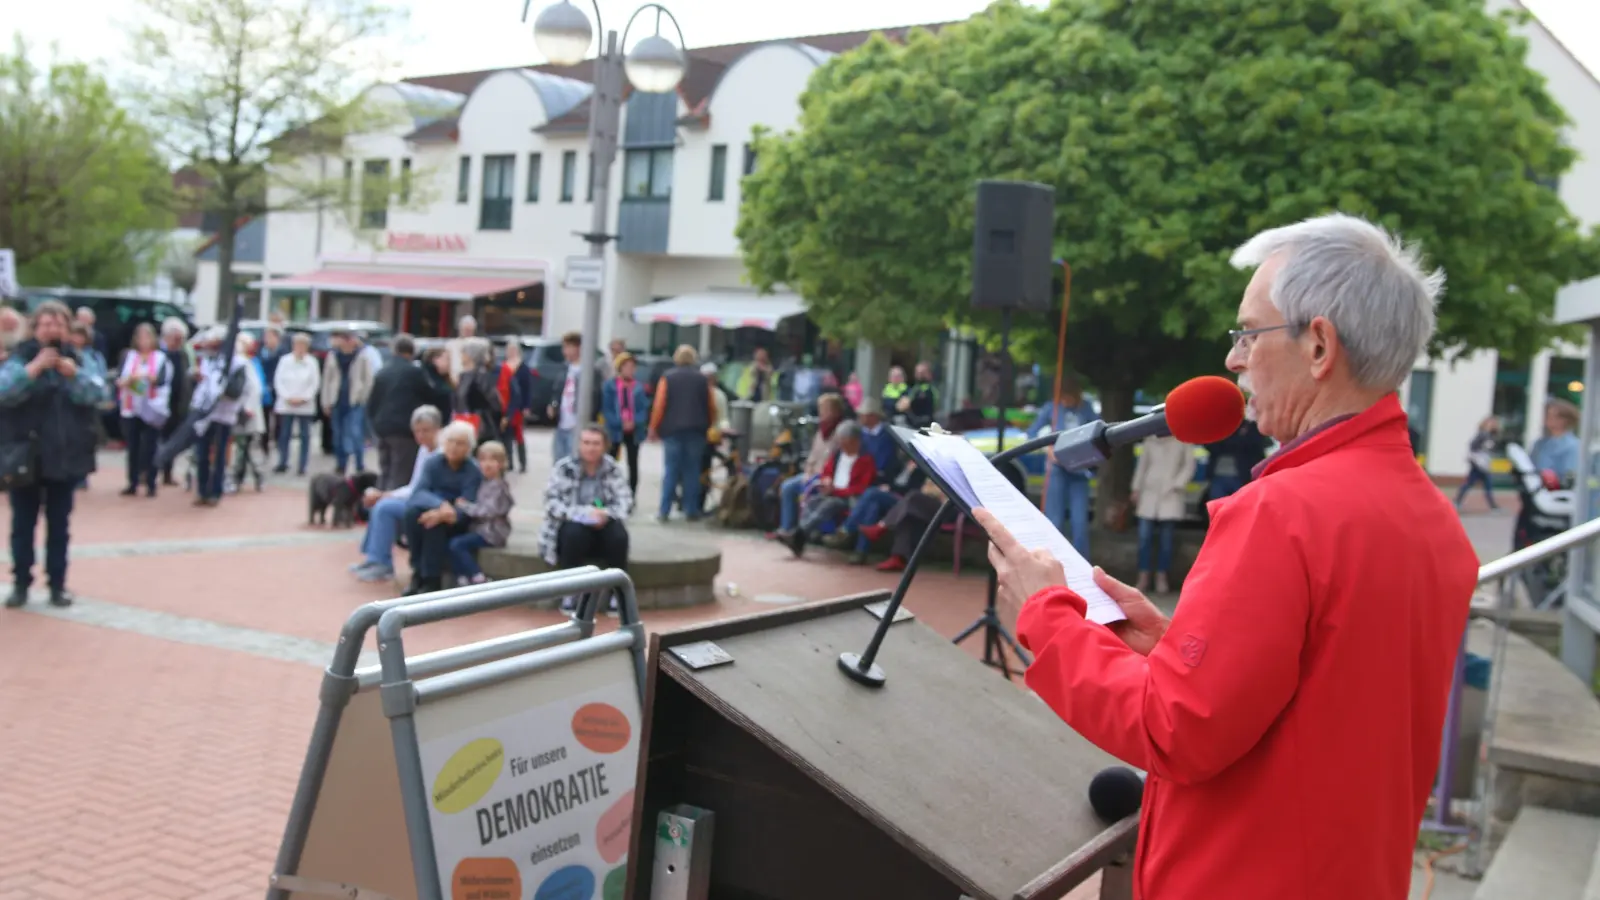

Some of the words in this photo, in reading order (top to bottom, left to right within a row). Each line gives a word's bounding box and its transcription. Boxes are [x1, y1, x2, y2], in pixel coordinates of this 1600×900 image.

[510, 756, 529, 777] Für
[531, 746, 567, 770] unsere
[476, 762, 610, 846] DEMOKRATIE
[530, 832, 581, 865] einsetzen
